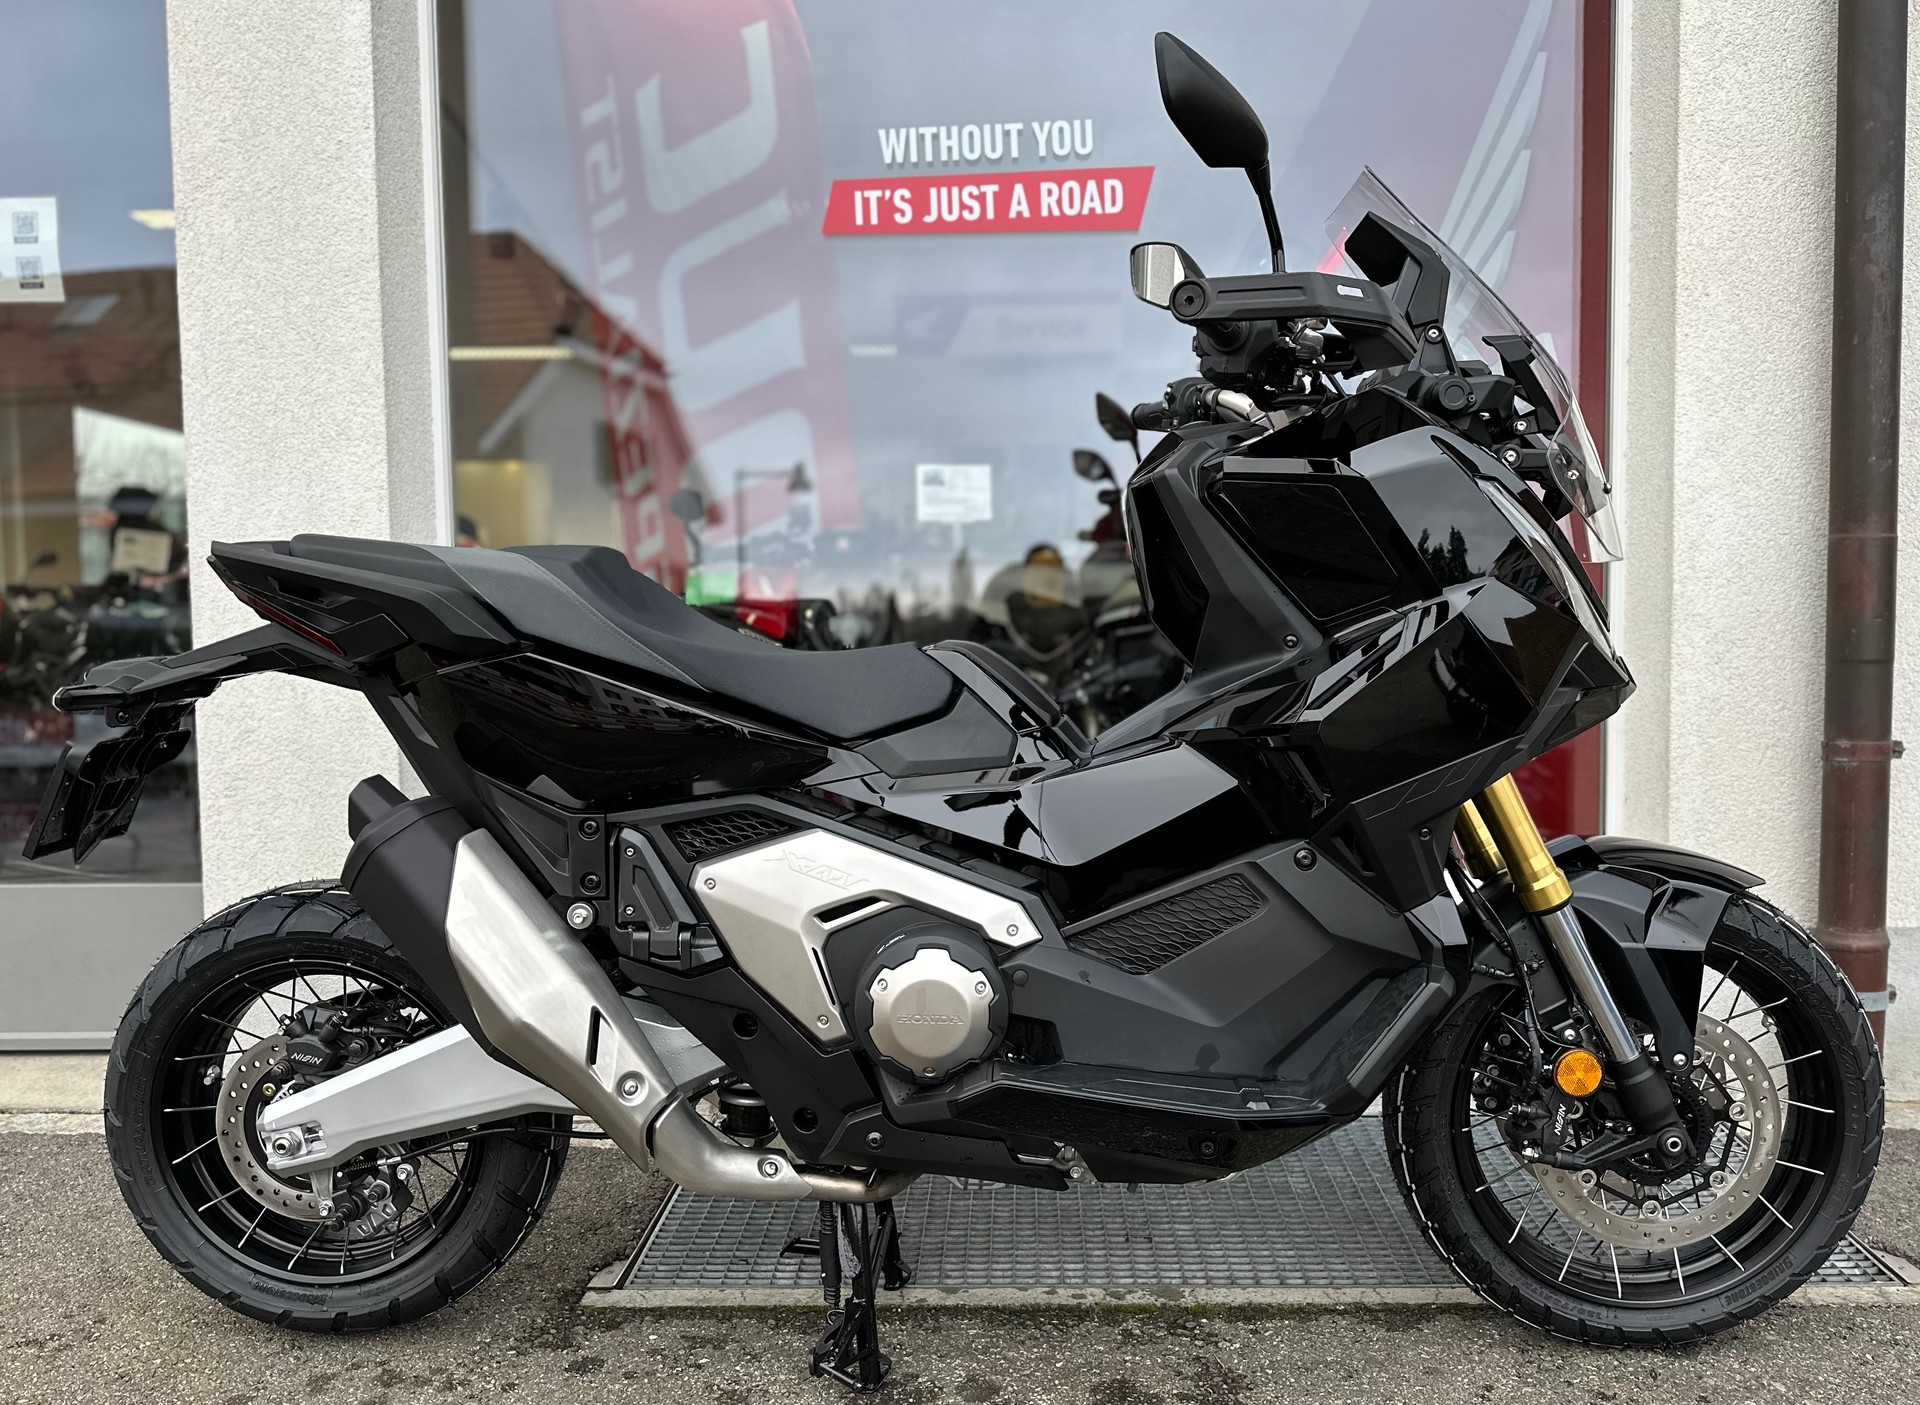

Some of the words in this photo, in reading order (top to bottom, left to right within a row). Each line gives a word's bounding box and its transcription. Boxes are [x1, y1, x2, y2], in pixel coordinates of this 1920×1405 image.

[878, 123, 1023, 164] WITHOUT
[1032, 119, 1094, 157] YOU
[855, 189, 913, 226] IT'S
[923, 184, 999, 223] JUST
[1009, 183, 1031, 219] A
[1040, 178, 1124, 218] ROAD
[896, 1013, 965, 1026] HONDA
[1724, 1254, 1795, 1307] BRIDGESTONE
